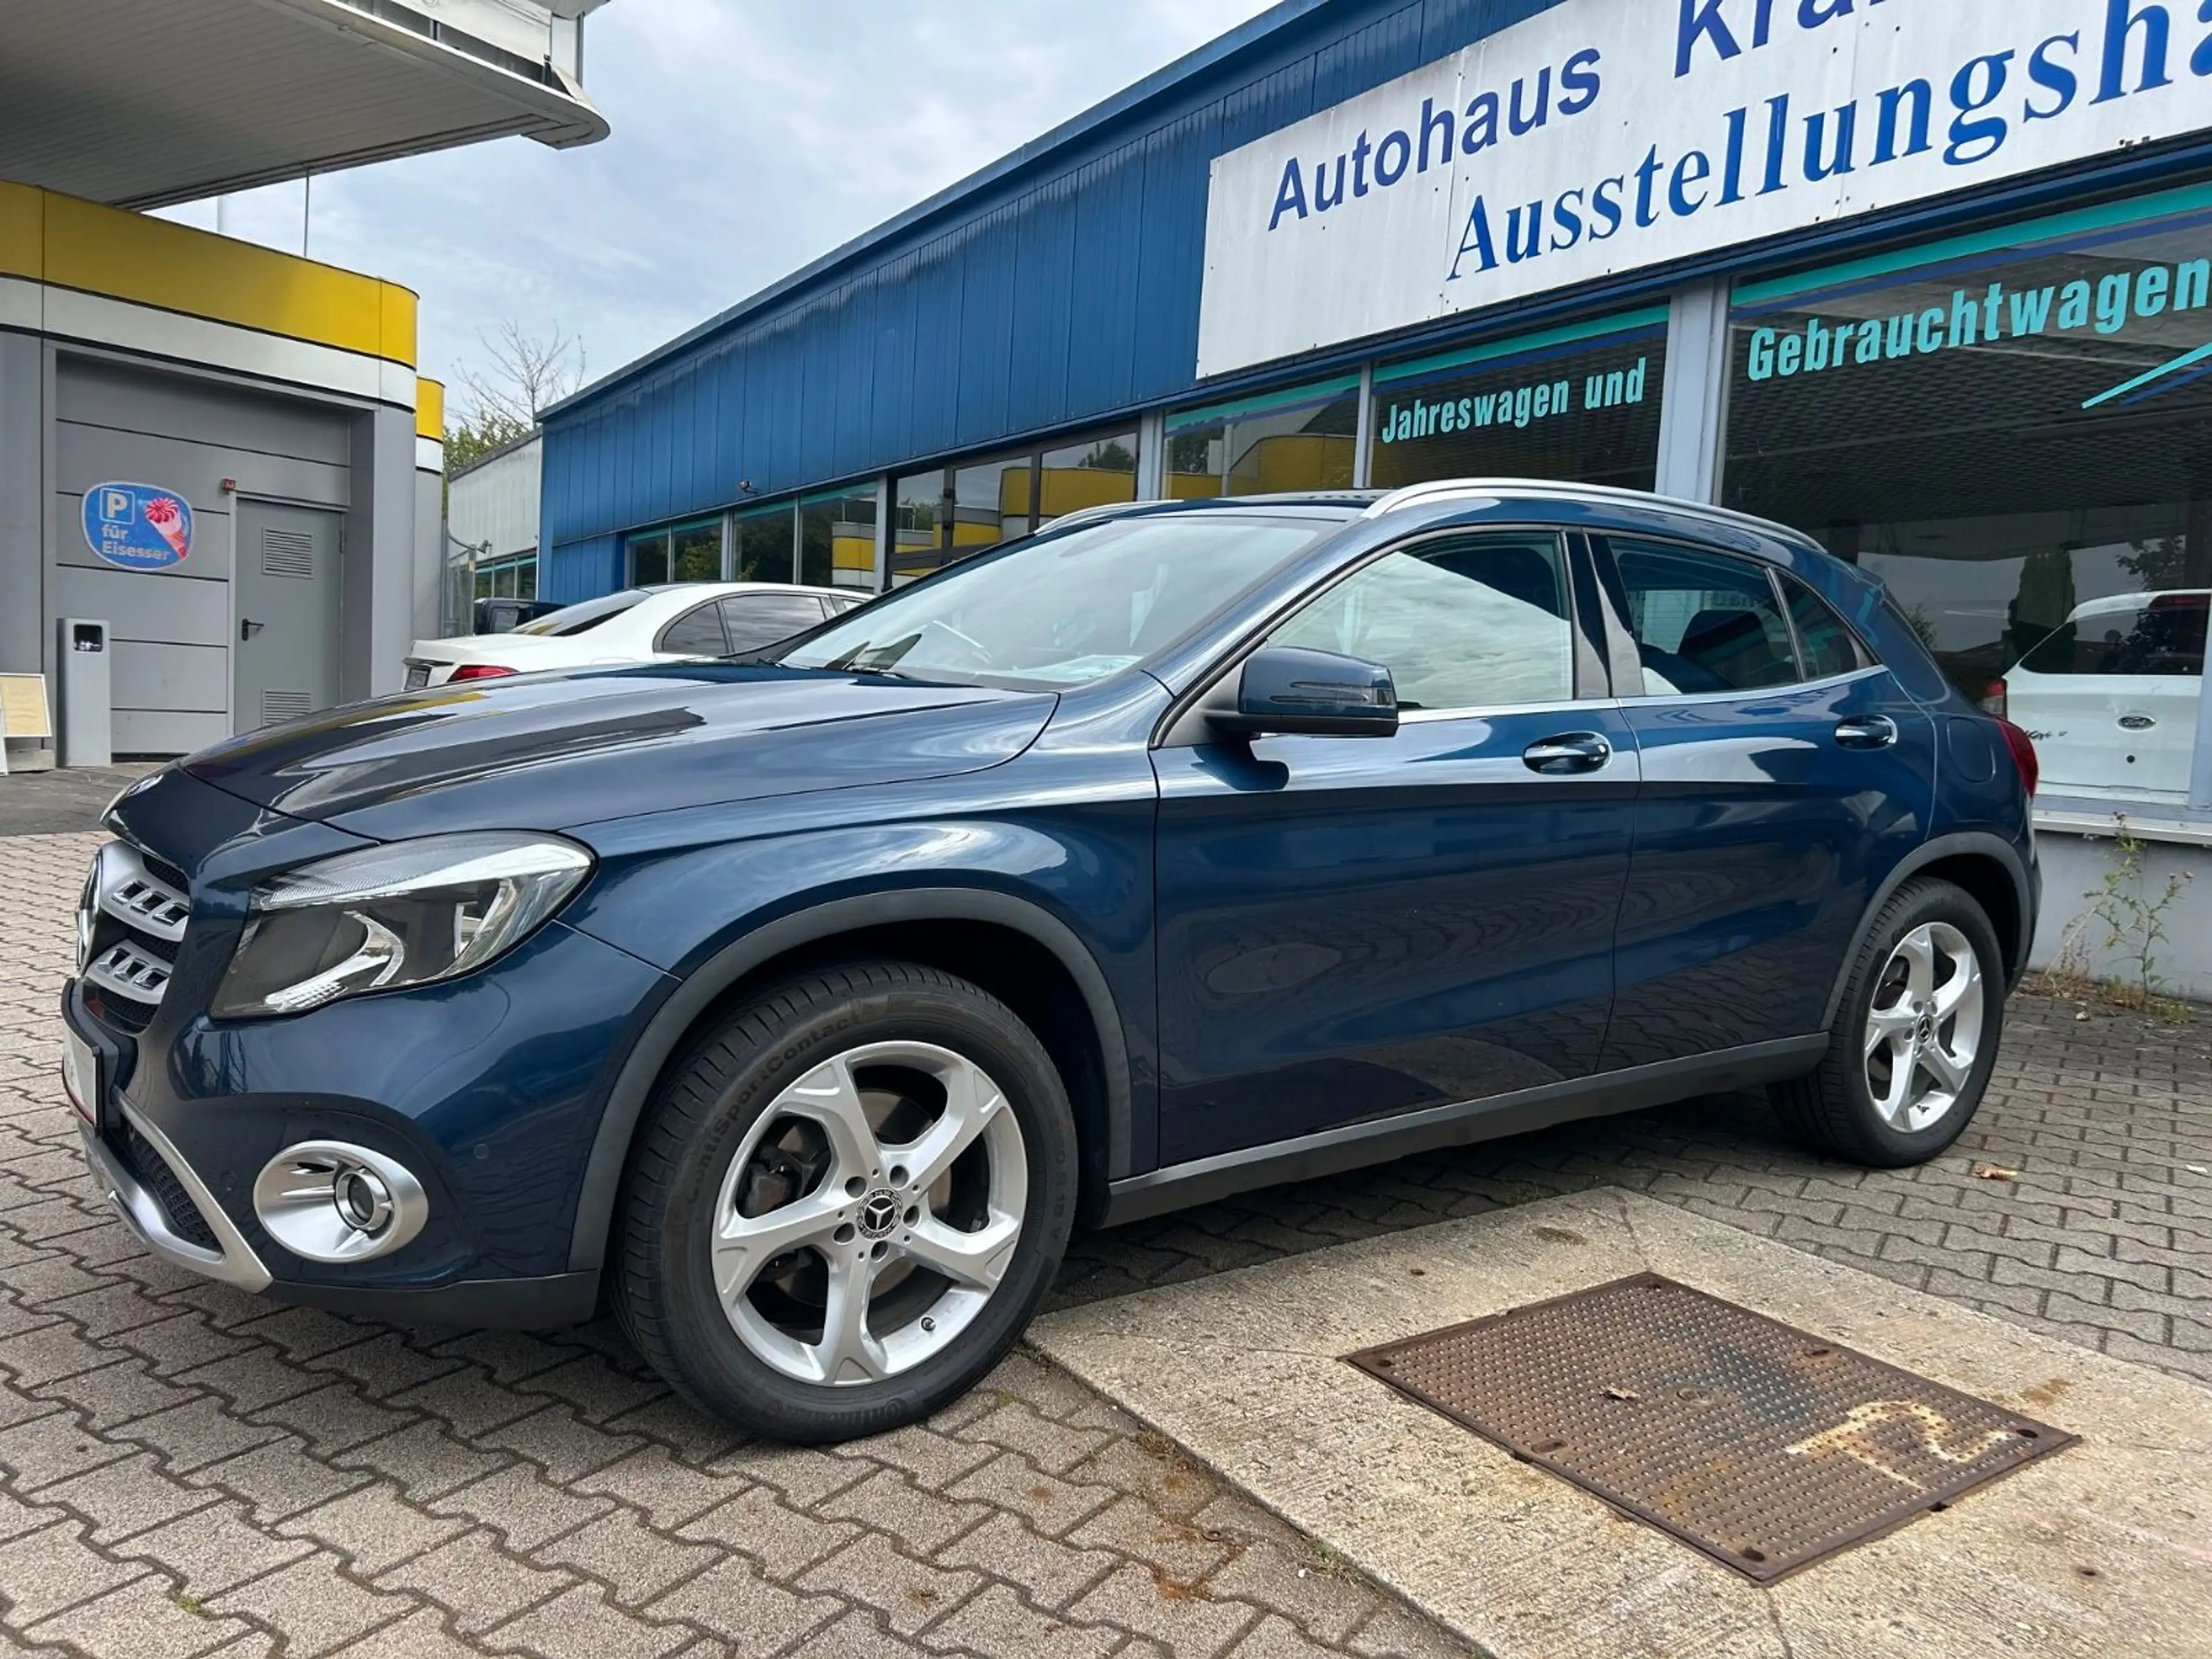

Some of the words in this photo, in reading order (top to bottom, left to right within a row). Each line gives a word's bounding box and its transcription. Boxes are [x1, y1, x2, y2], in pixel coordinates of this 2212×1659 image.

[1267, 48, 1601, 232] Autohaus
[1747, 257, 2211, 381] Gebrauchtwagen
[1382, 379, 1569, 444] Jahreswagen
[1585, 357, 1646, 410] und
[101, 524, 128, 540] für
[107, 493, 127, 518] P
[102, 540, 171, 560] Eisesser
